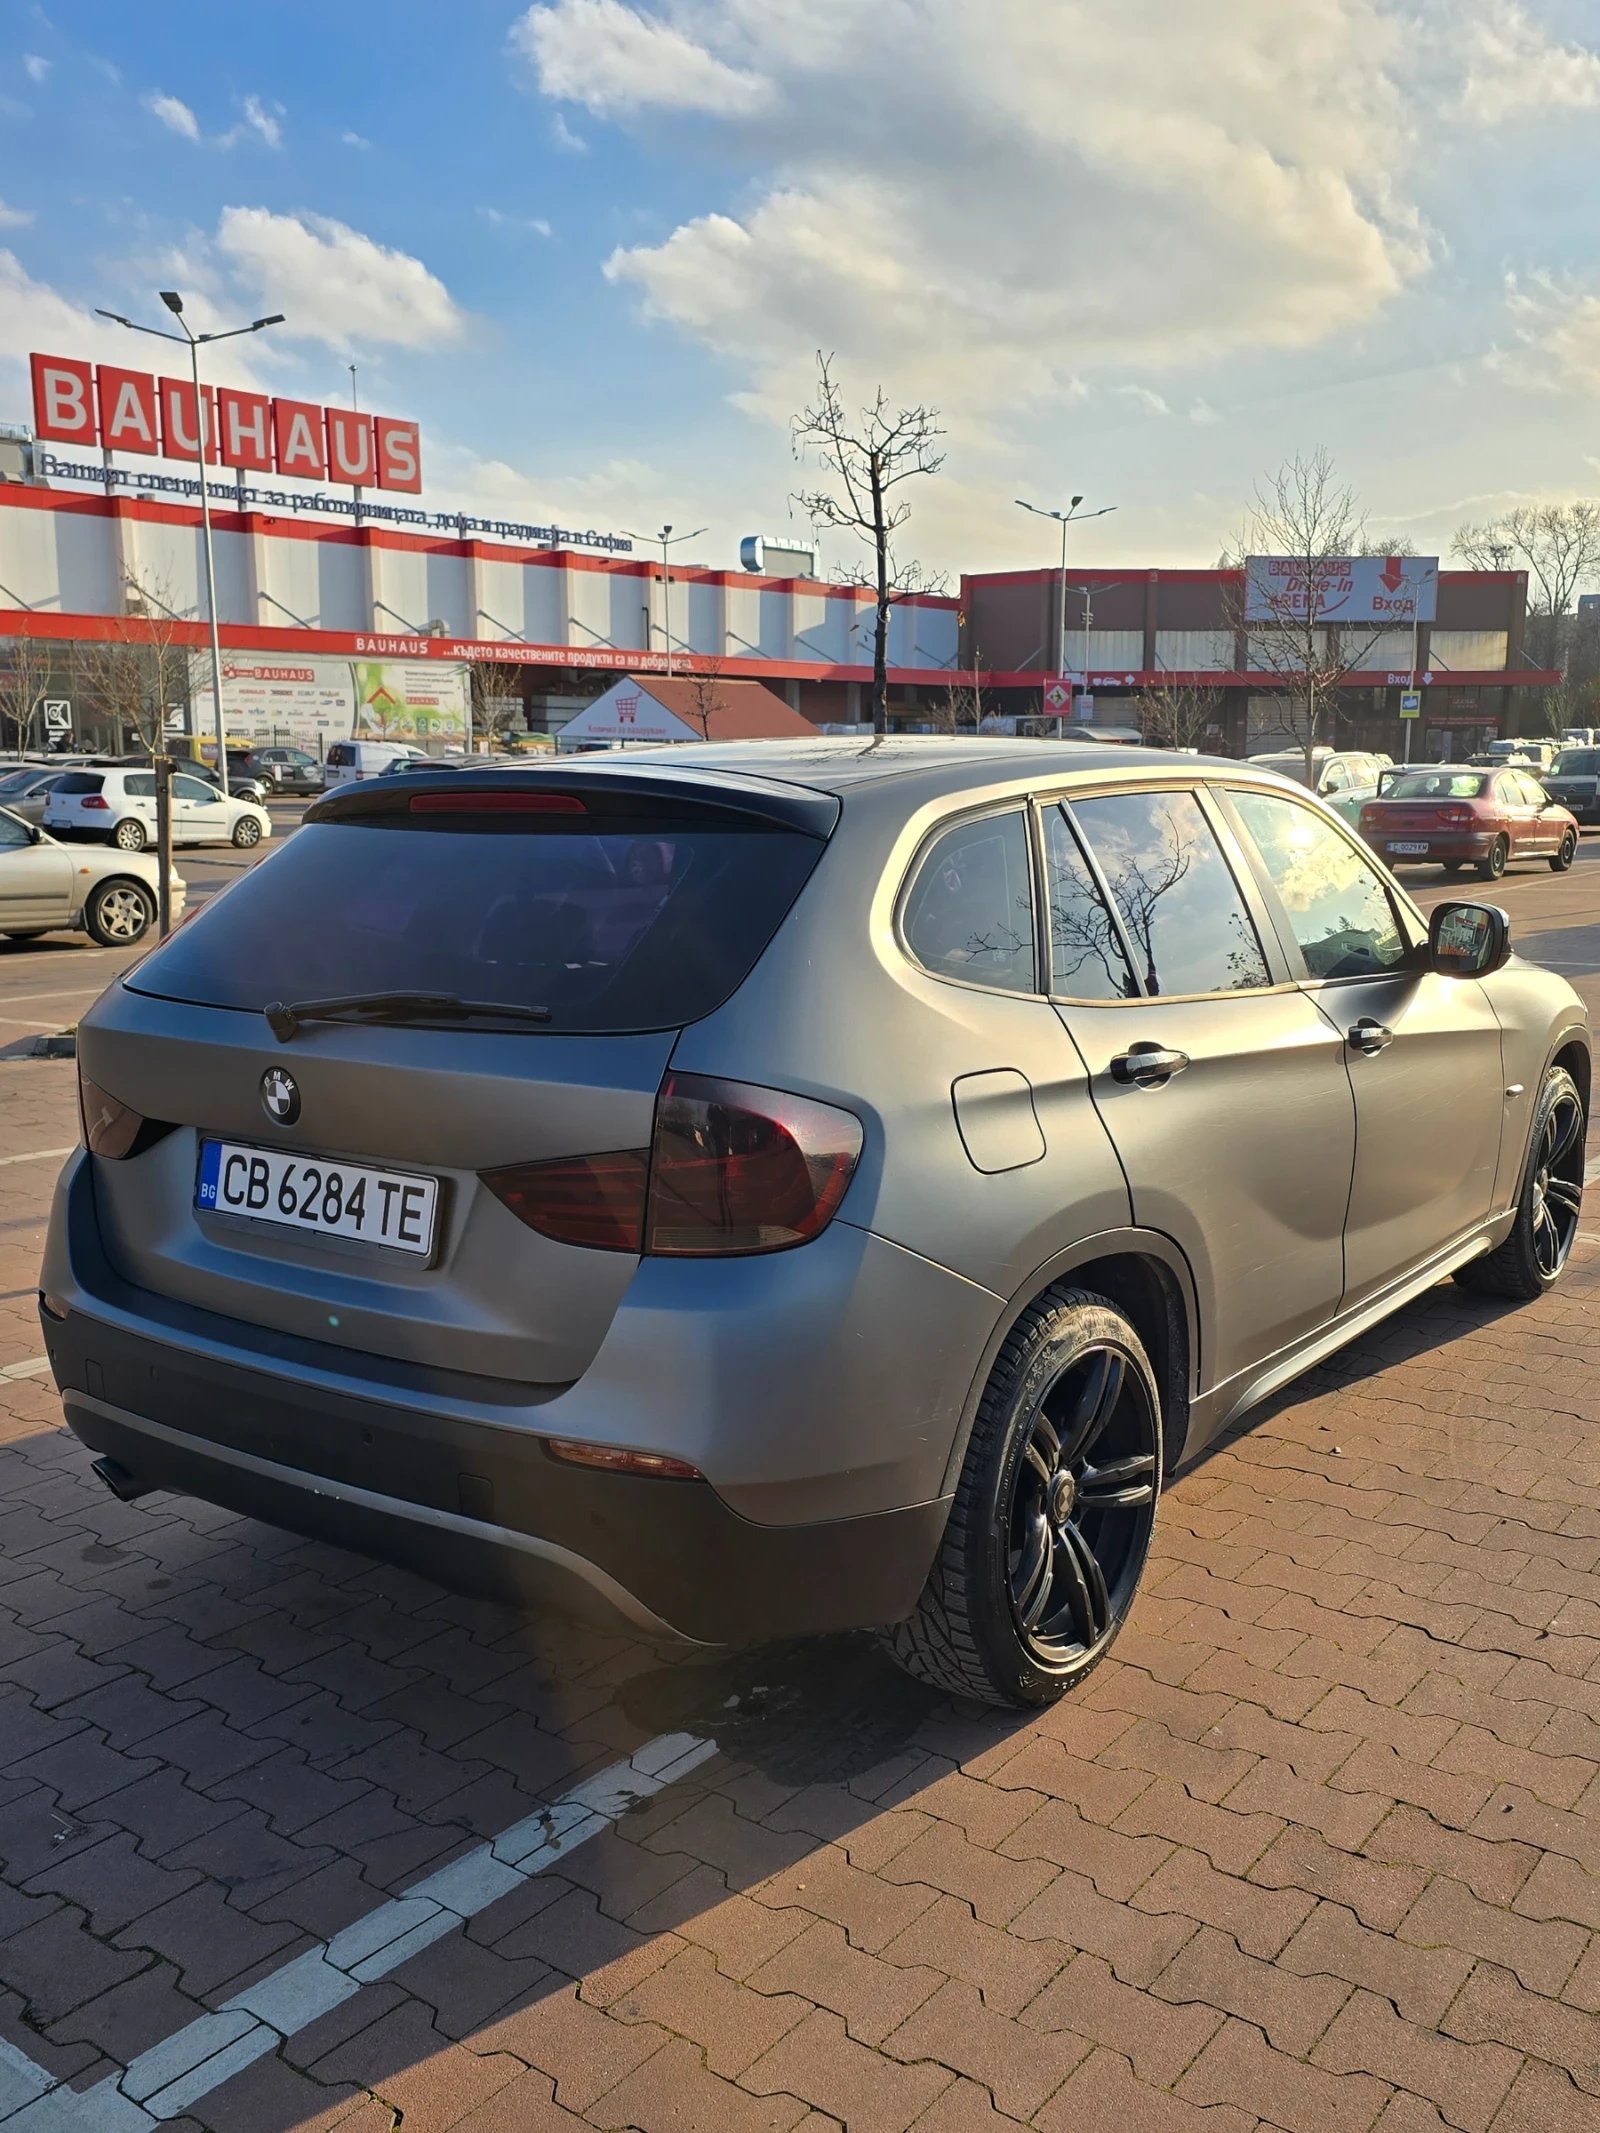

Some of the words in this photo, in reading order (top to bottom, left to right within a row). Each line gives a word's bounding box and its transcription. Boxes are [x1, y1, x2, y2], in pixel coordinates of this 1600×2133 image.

[43, 368, 416, 482] BAUHAUS
[41, 453, 131, 485] Вашият
[137, 472, 259, 502] специалист
[265, 490, 287, 506] за
[436, 512, 477, 531] дома
[482, 519, 491, 532] и
[495, 521, 569, 541] градината
[574, 532, 583, 544] в
[587, 529, 633, 552] София
[1372, 596, 1414, 614] Вход
[356, 637, 428, 654] BAUHAUS
[443, 644, 492, 659] ...където
[495, 646, 566, 662] качествените
[567, 653, 613, 668] продукти
[615, 655, 626, 665] са
[628, 656, 639, 667] на
[641, 654, 669, 671] добра
[254, 668, 314, 680] BAUHAUS
[263, 1070, 295, 1091] BMW
[201, 1183, 216, 1198] BG
[223, 1153, 270, 1210] CB
[277, 1163, 367, 1231] 6284
[377, 1180, 426, 1244] TE
